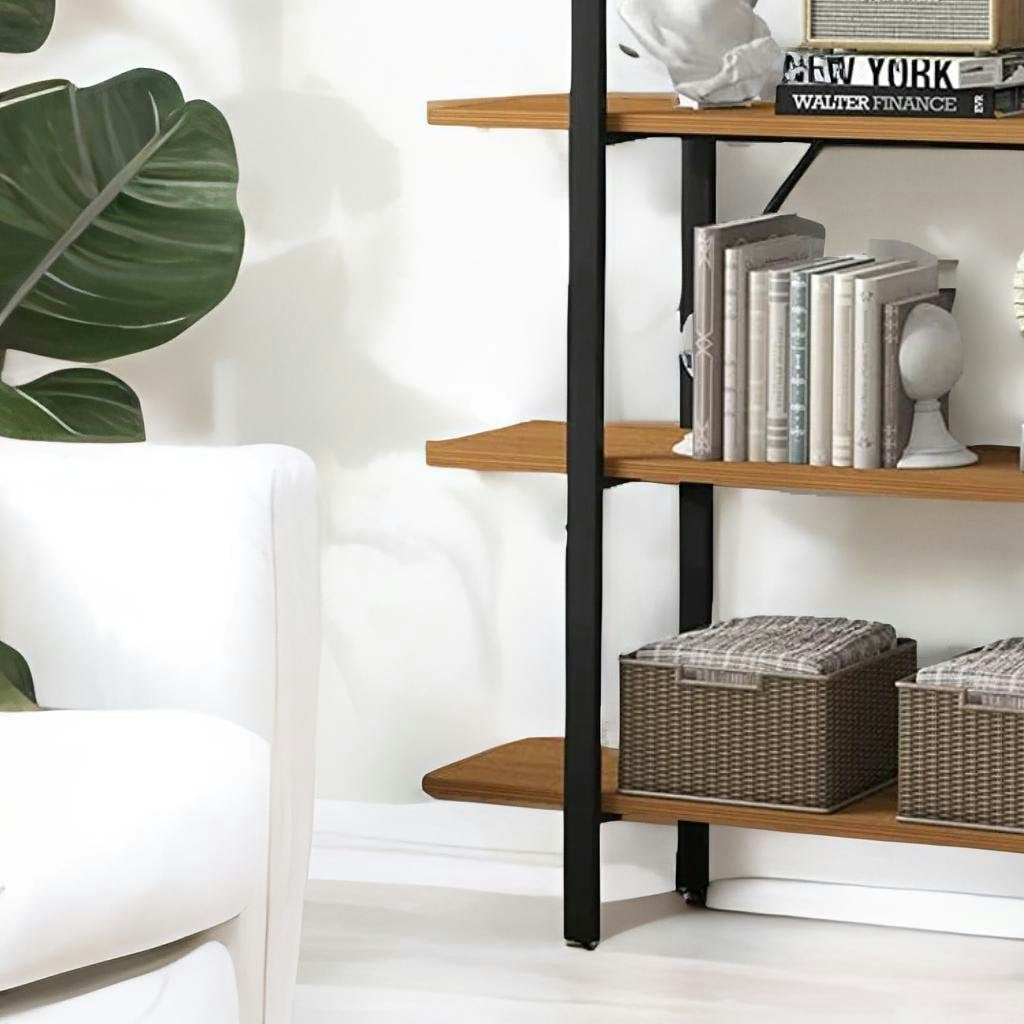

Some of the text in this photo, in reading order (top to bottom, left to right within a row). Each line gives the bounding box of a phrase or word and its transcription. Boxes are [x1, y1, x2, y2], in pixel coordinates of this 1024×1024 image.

[868, 57, 952, 88] YORK
[792, 94, 957, 112] WALTER FINANCE
